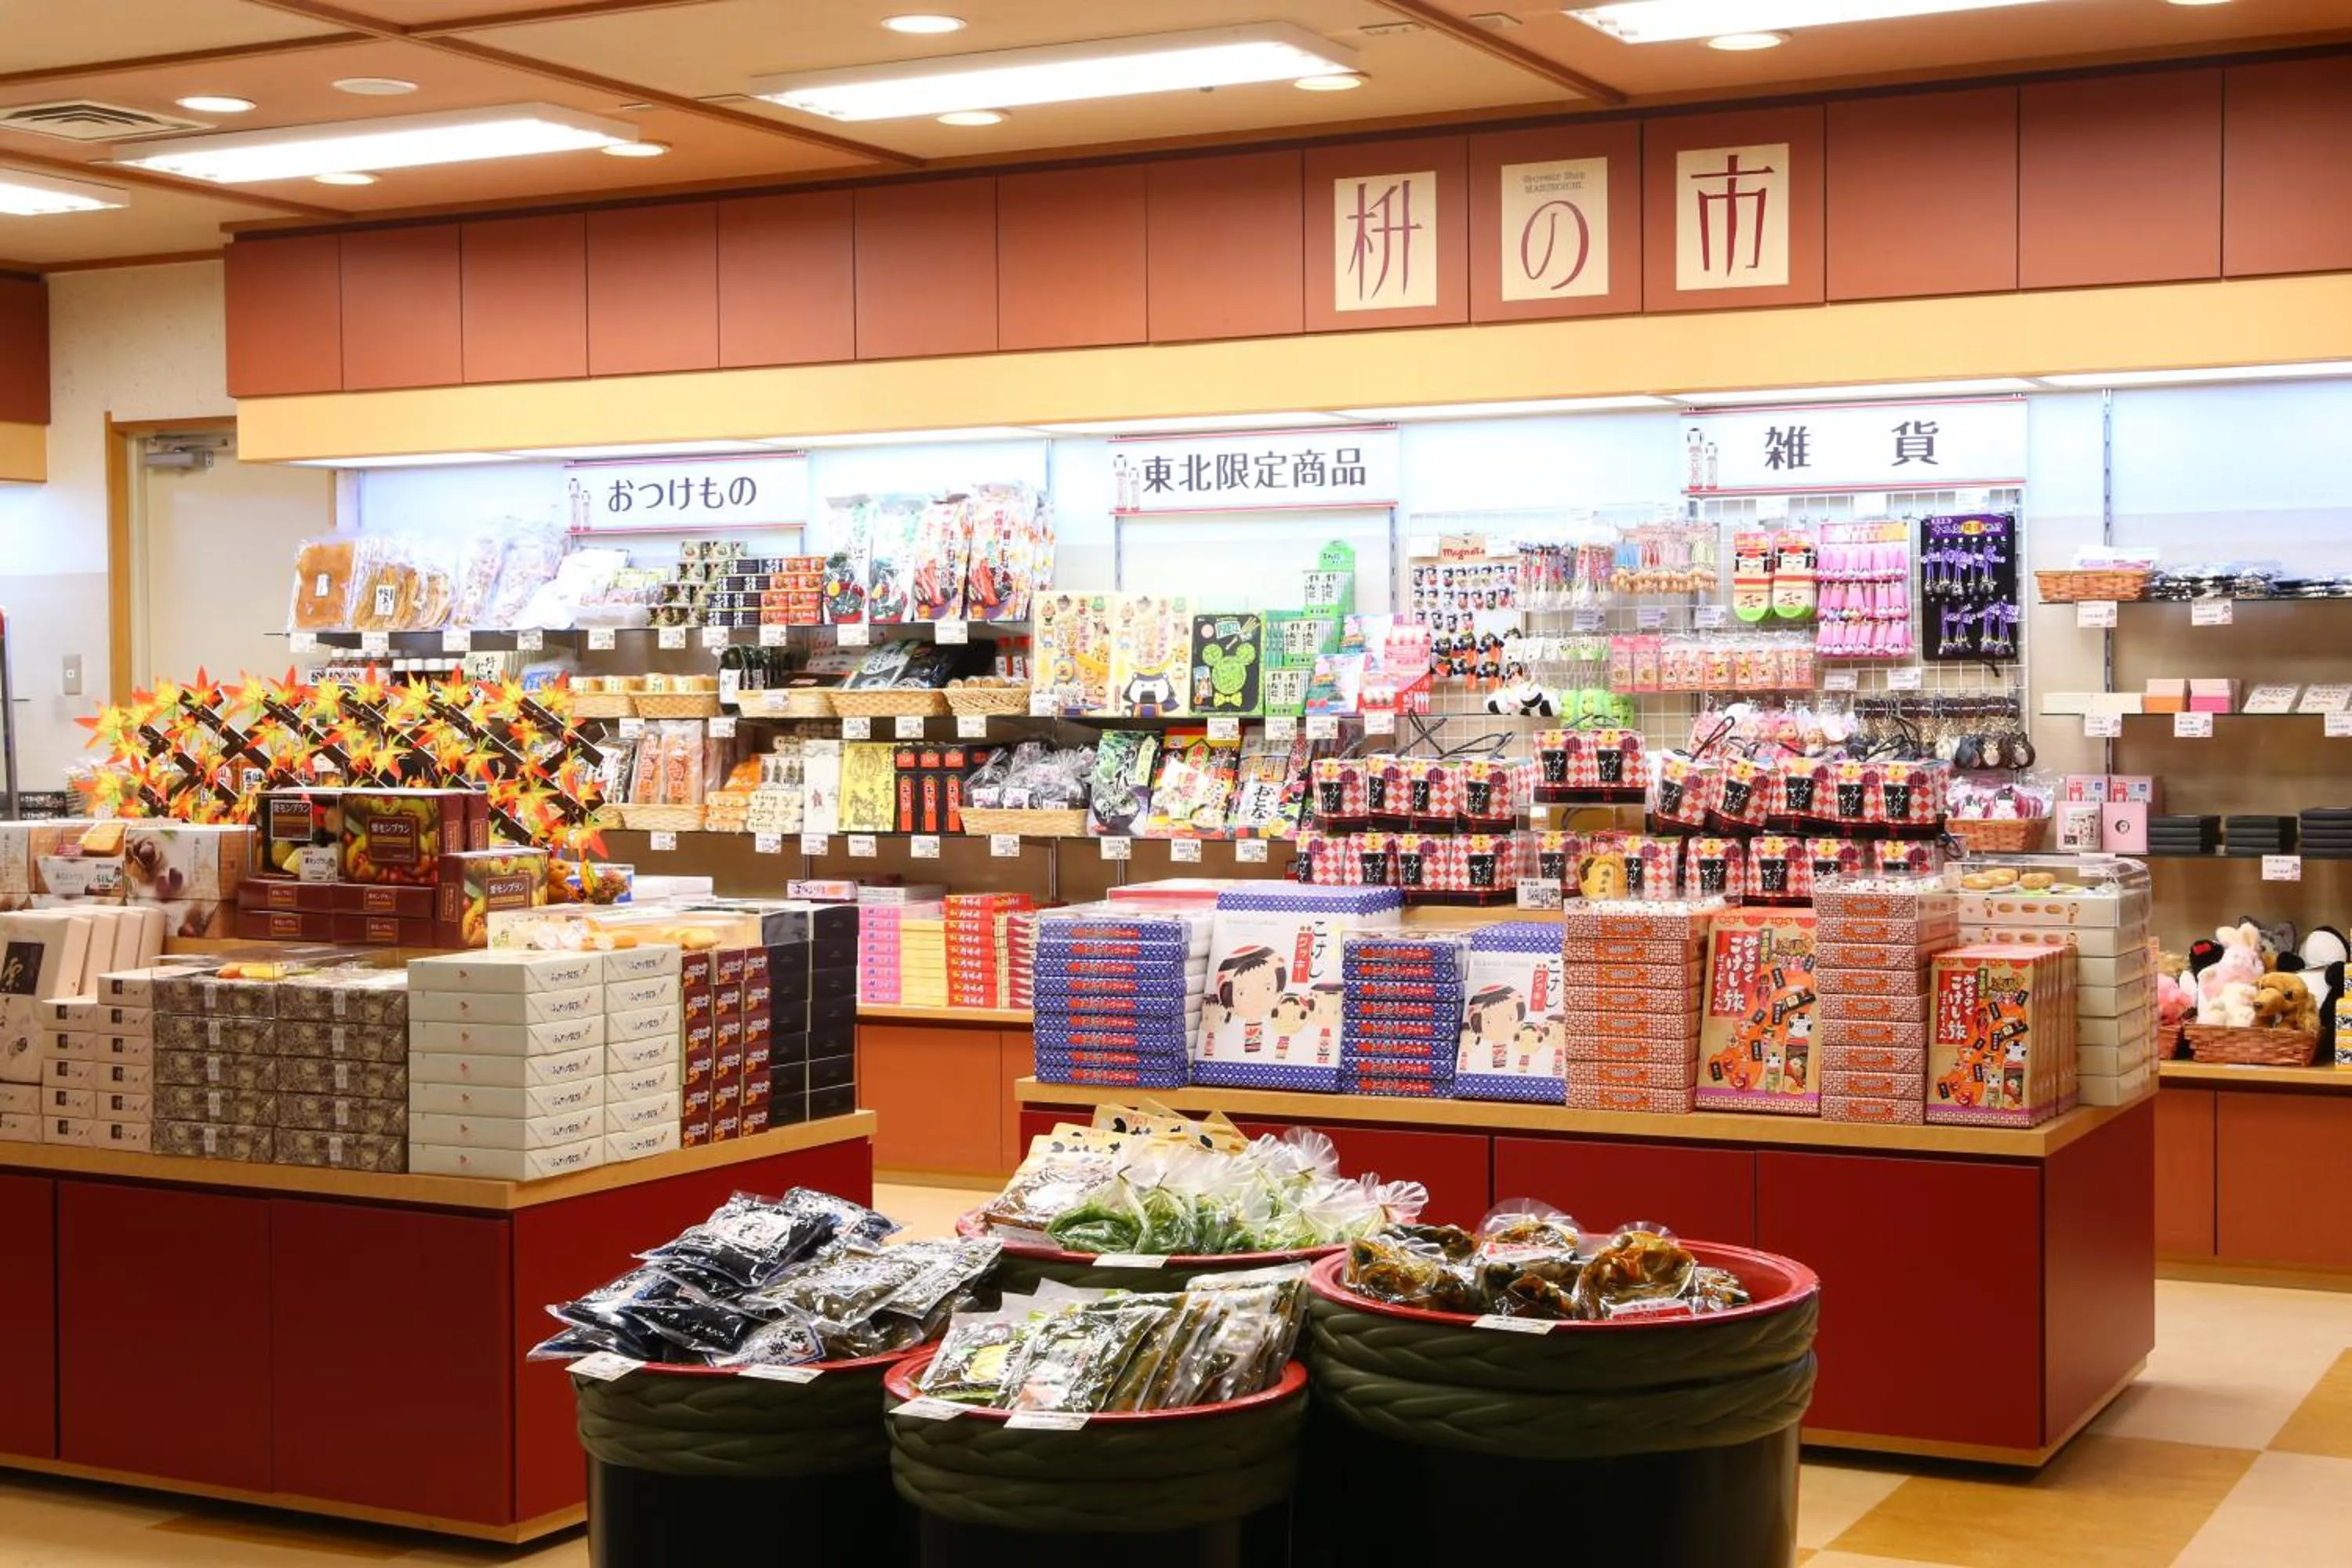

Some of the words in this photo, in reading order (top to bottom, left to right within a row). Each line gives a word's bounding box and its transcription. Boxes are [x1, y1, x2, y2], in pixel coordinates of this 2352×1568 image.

[1764, 420, 1939, 470] 雑貨
[608, 476, 757, 513] おつけもの
[1142, 448, 1367, 493] 東北限定商品
[1308, 921, 1328, 978] こけし
[1545, 959, 1561, 1007] こけし
